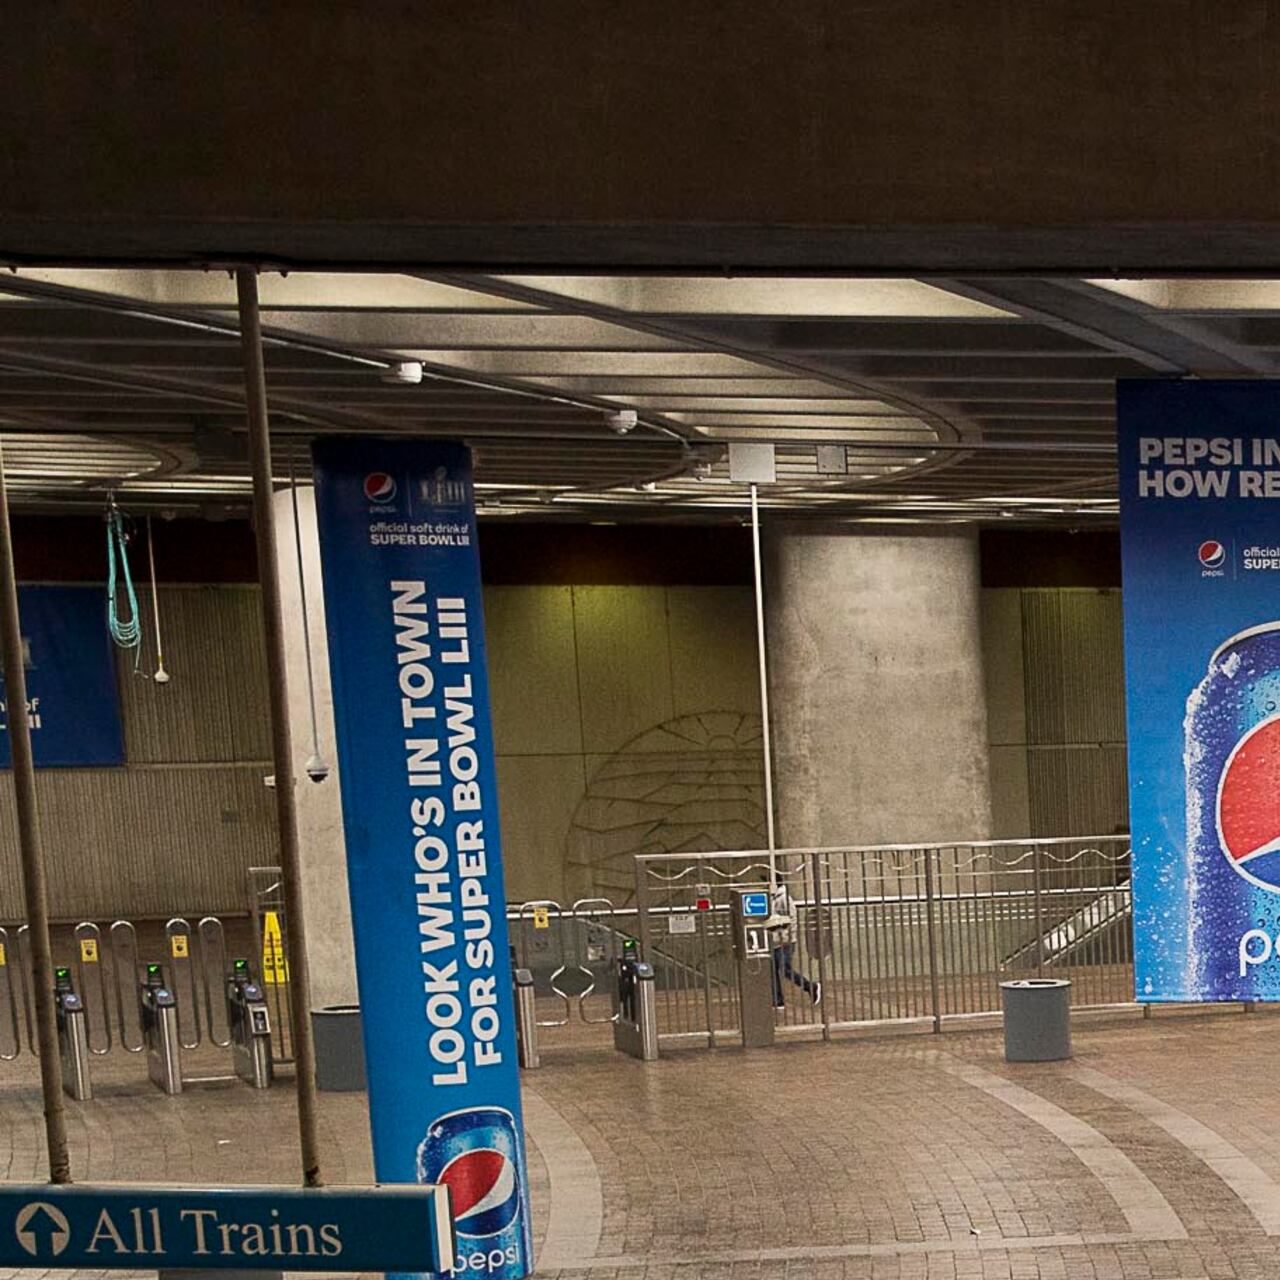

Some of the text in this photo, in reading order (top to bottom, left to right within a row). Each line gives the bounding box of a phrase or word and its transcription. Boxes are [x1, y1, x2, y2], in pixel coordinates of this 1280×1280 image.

[1139, 437, 1242, 466] PEPSI
[1139, 470, 1231, 498] HOW
[369, 522, 407, 533] official
[409, 522, 433, 533] soft
[435, 523, 460, 534] drink
[370, 534, 417, 545] SUPER
[419, 535, 455, 545] BOWL
[1243, 546, 1280, 558] official
[390, 580, 468, 1086] LOOK WHO'S IN TOWN
[436, 598, 502, 1066] FOR SUPER BOWL LIII
[86, 1206, 343, 1257] All Trains
[450, 1243, 519, 1278] pepsi
